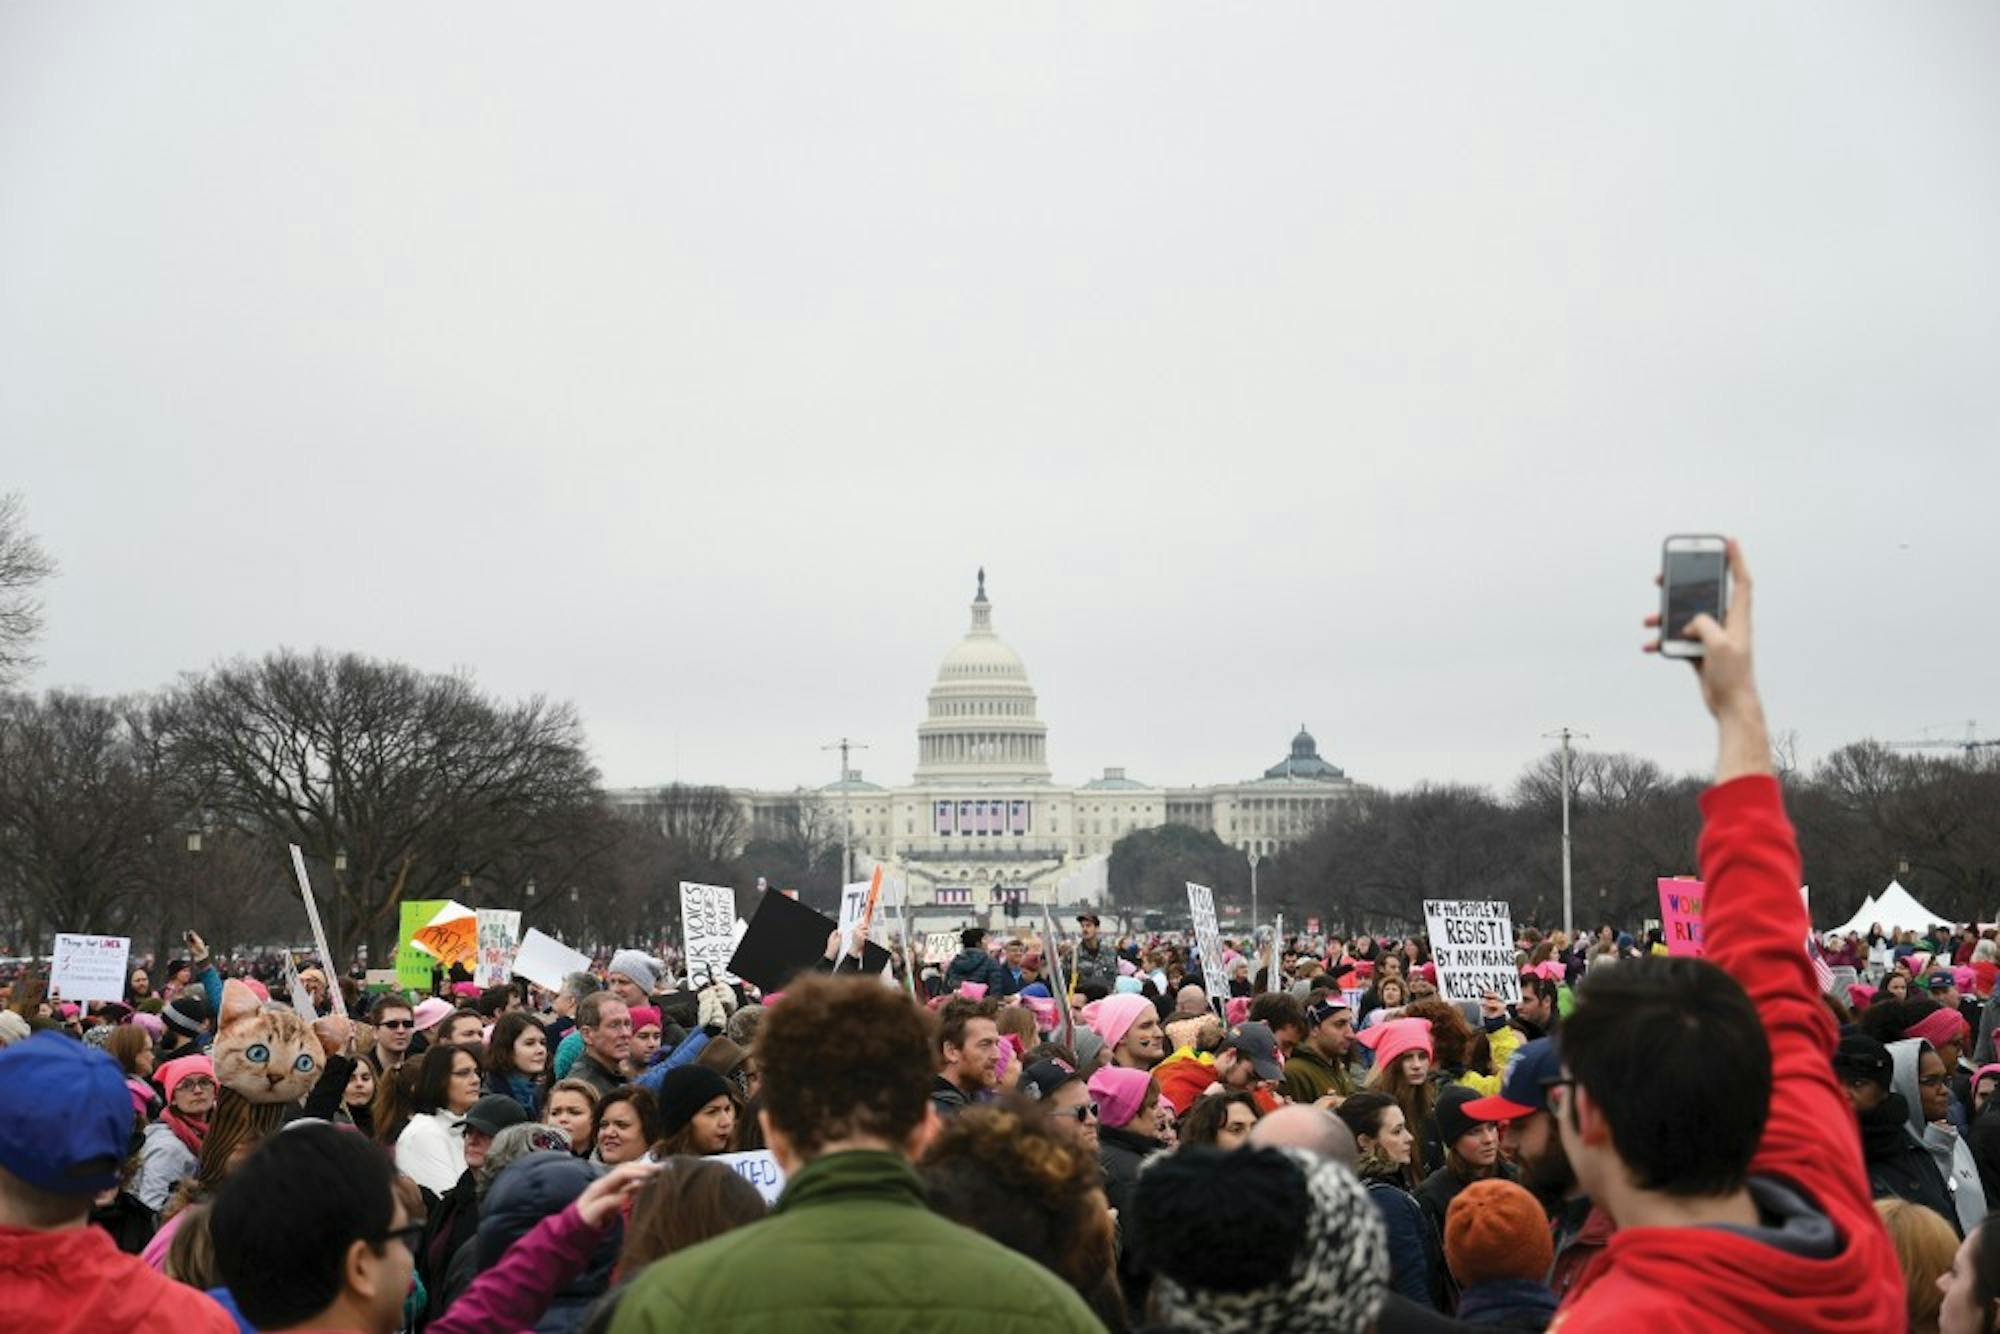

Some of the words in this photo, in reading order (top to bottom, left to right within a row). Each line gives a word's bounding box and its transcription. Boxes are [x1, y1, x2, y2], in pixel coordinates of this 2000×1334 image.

[685, 886, 705, 940] VOICES
[1426, 902, 1441, 917] WE
[1459, 901, 1491, 918] PEOPLE
[1445, 918, 1505, 946] RESIST!
[1436, 946, 1452, 967] BY
[1457, 949, 1479, 967] ANY
[1480, 949, 1515, 967] MEANS
[1444, 971, 1520, 1001] NECESSARY
